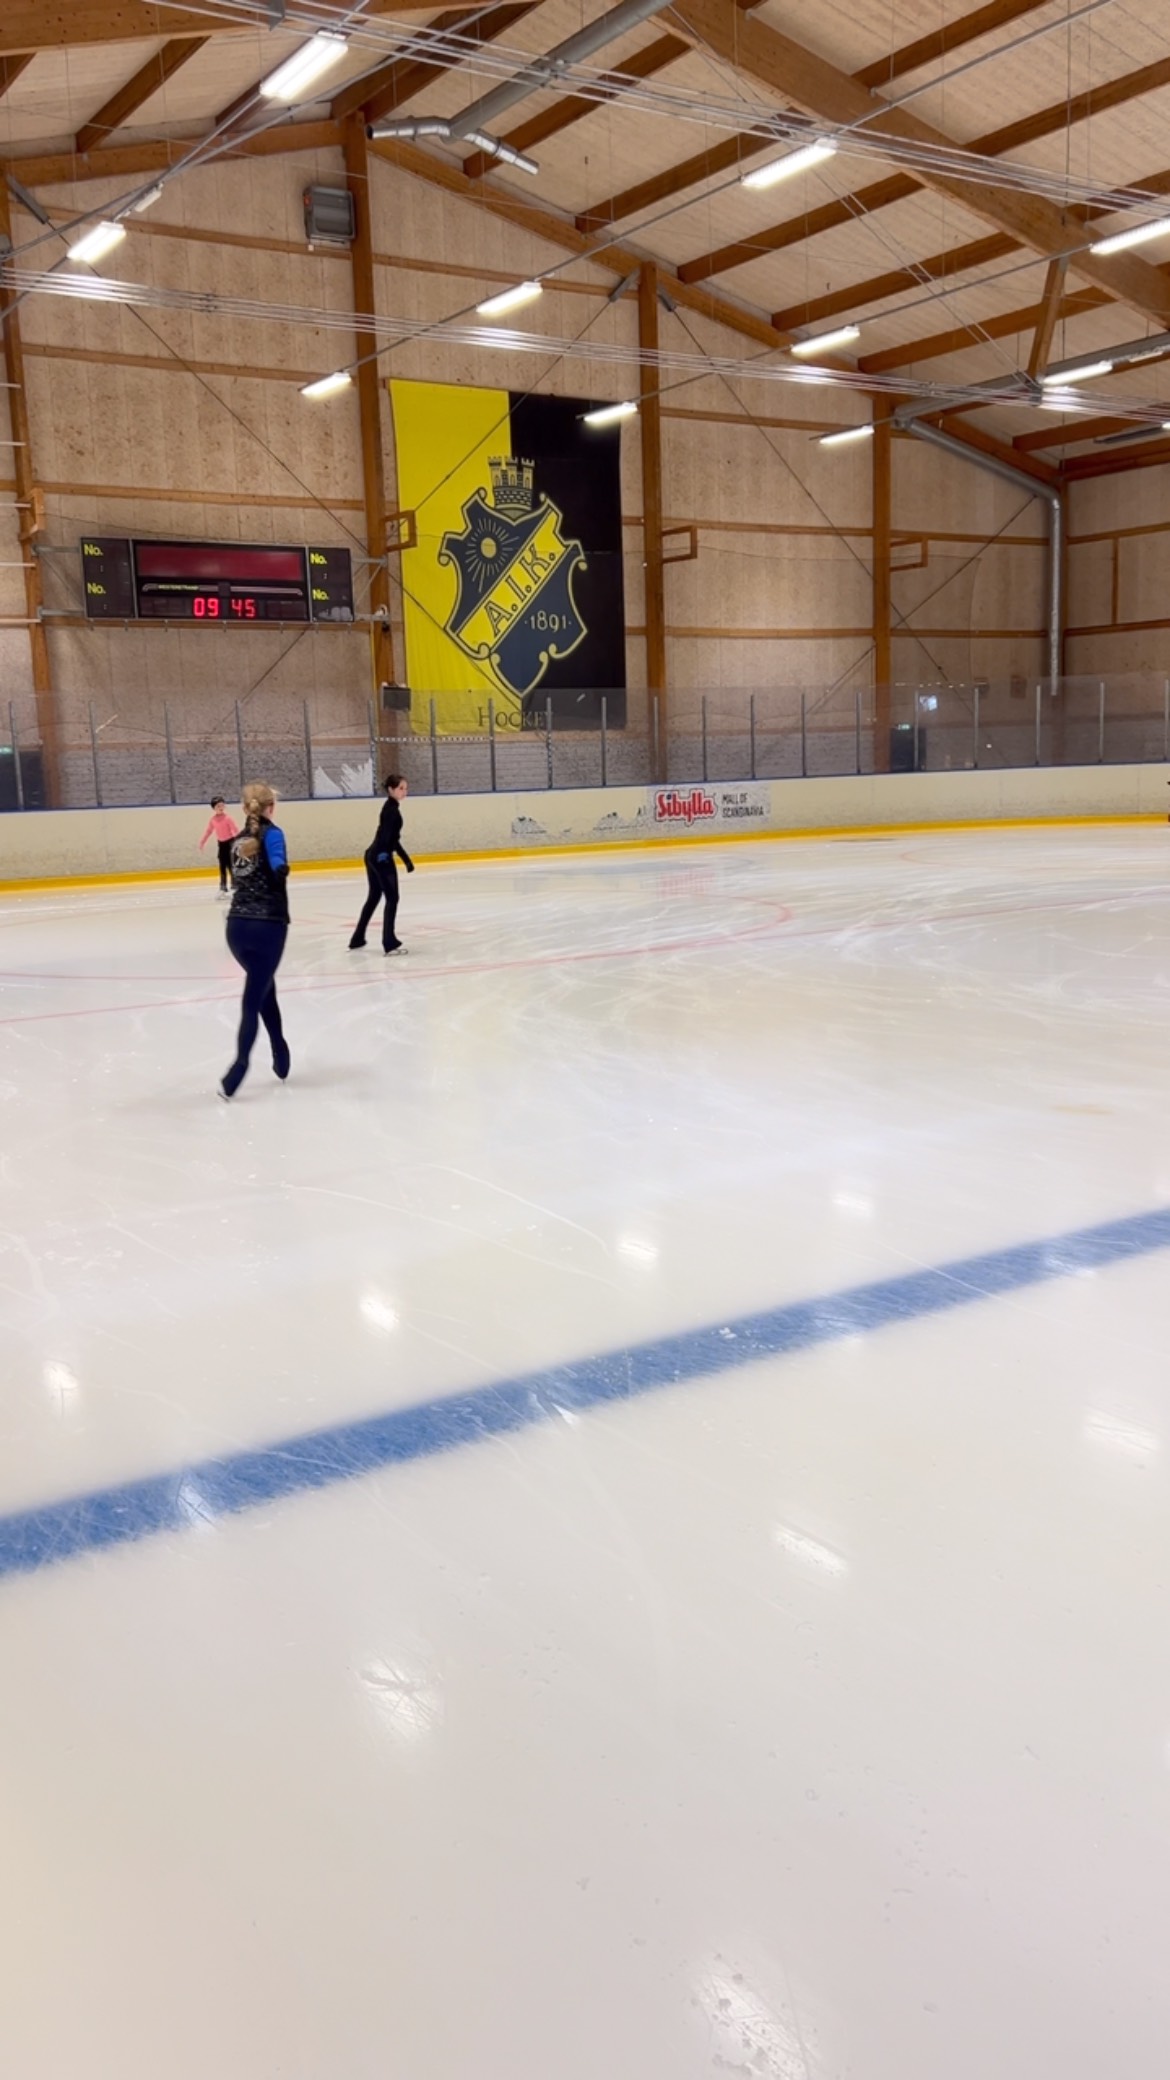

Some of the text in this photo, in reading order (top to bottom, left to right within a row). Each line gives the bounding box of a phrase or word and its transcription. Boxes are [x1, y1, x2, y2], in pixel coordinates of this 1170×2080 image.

[84, 544, 103, 556] No.
[310, 553, 327, 565] No.
[87, 582, 106, 594] No.
[312, 589, 329, 601] No.
[194, 598, 256, 617] 09 45
[657, 792, 714, 823] Sibylla
